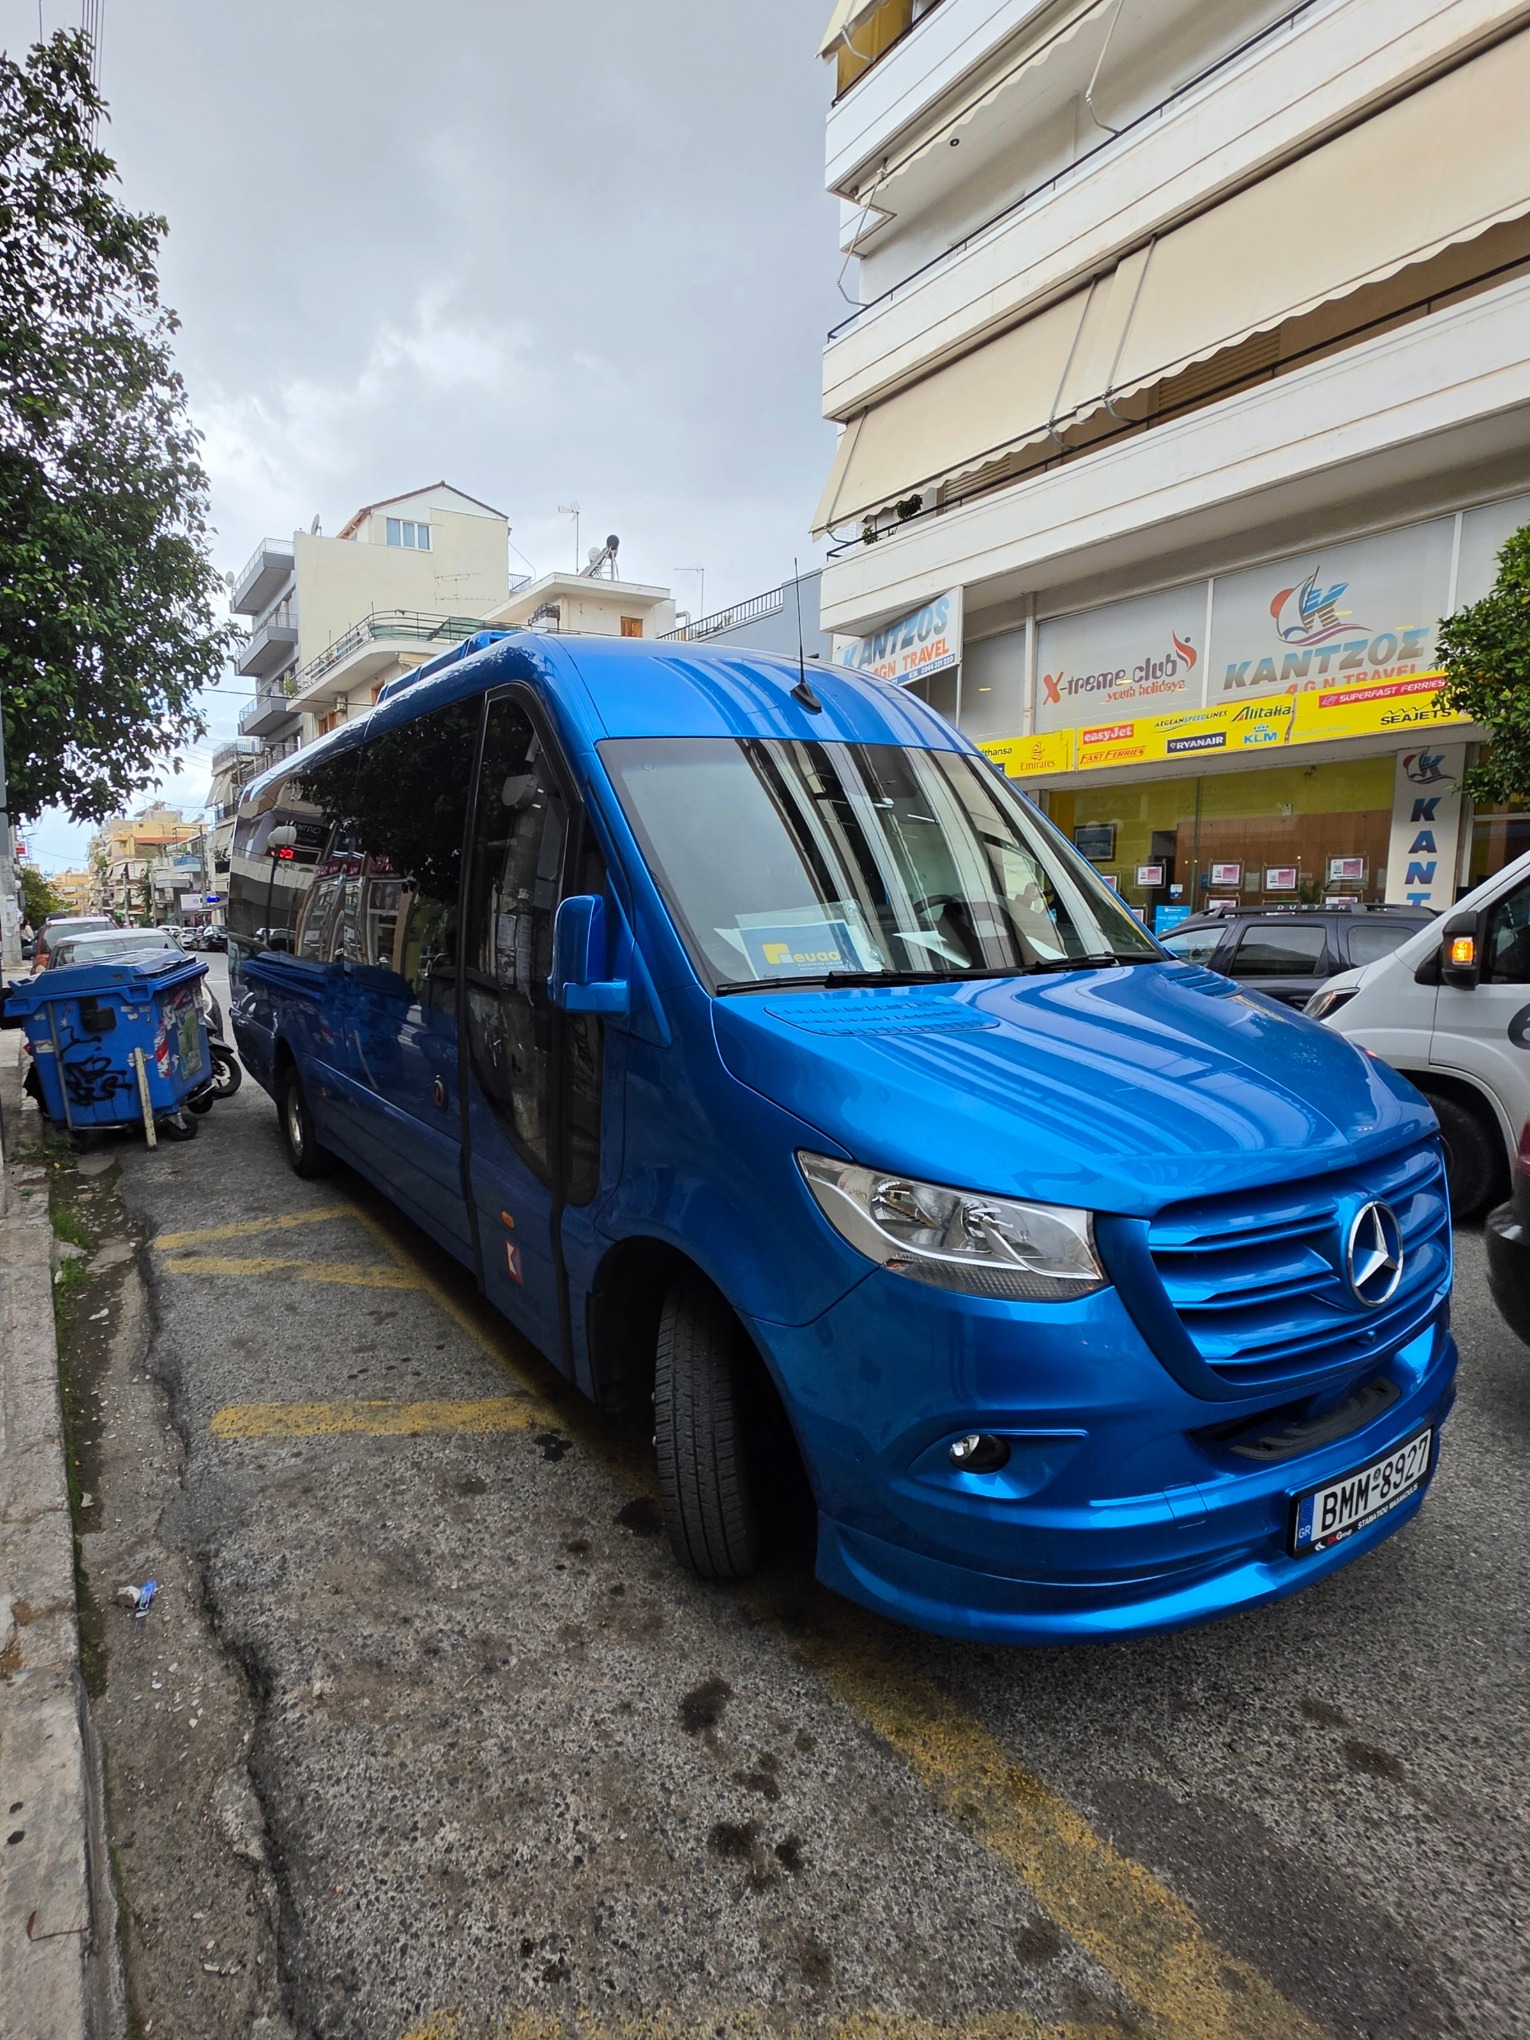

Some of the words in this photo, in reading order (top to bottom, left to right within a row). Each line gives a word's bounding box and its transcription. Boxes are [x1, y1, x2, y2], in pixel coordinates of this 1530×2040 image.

[843, 596, 950, 669] KANTZOS
[903, 637, 950, 671] TRAVEL
[1043, 668, 1126, 705] X-treme
[1132, 653, 1177, 684] club
[1106, 686, 1136, 702] youth
[1139, 679, 1186, 696] holidays
[1339, 687, 1398, 703] SUPERFAST
[1400, 678, 1446, 693] FERRIES
[1231, 705, 1292, 722] Alitalia
[1381, 709, 1452, 725] SEAJETS
[1084, 726, 1132, 743] easyJet
[1176, 736, 1224, 749] RYANAIR
[1244, 732, 1278, 744] KLM
[1020, 759, 1055, 771] Emirates
[1080, 752, 1103, 764] FAST
[793, 950, 842, 963] euaa
[1299, 1525, 1311, 1539] GR
